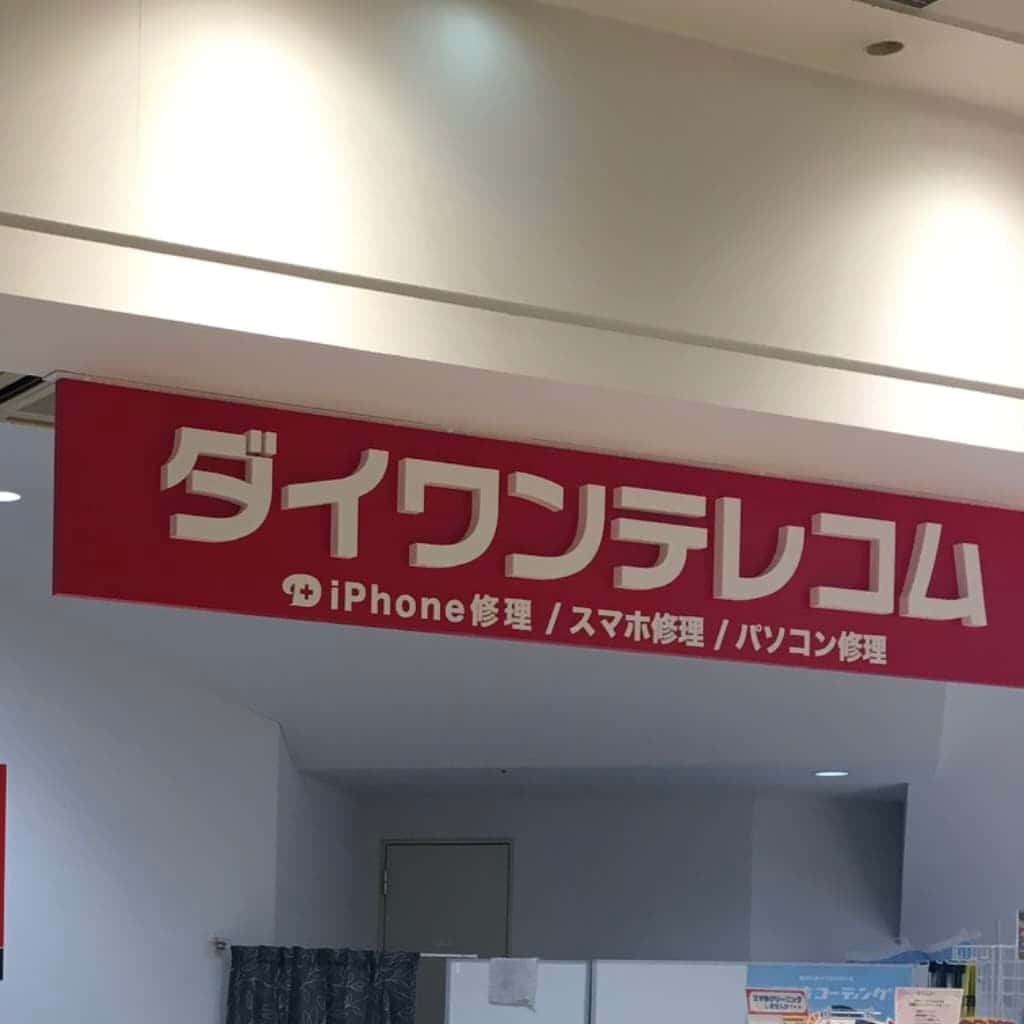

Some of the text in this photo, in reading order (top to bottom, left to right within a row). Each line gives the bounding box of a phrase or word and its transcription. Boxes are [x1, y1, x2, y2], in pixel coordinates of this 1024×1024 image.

[162, 427, 987, 628] ダイワンテレコム
[330, 580, 532, 632] iPhone修理
[570, 606, 704, 648] スマホ修理
[736, 625, 887, 665] パソコン修理
